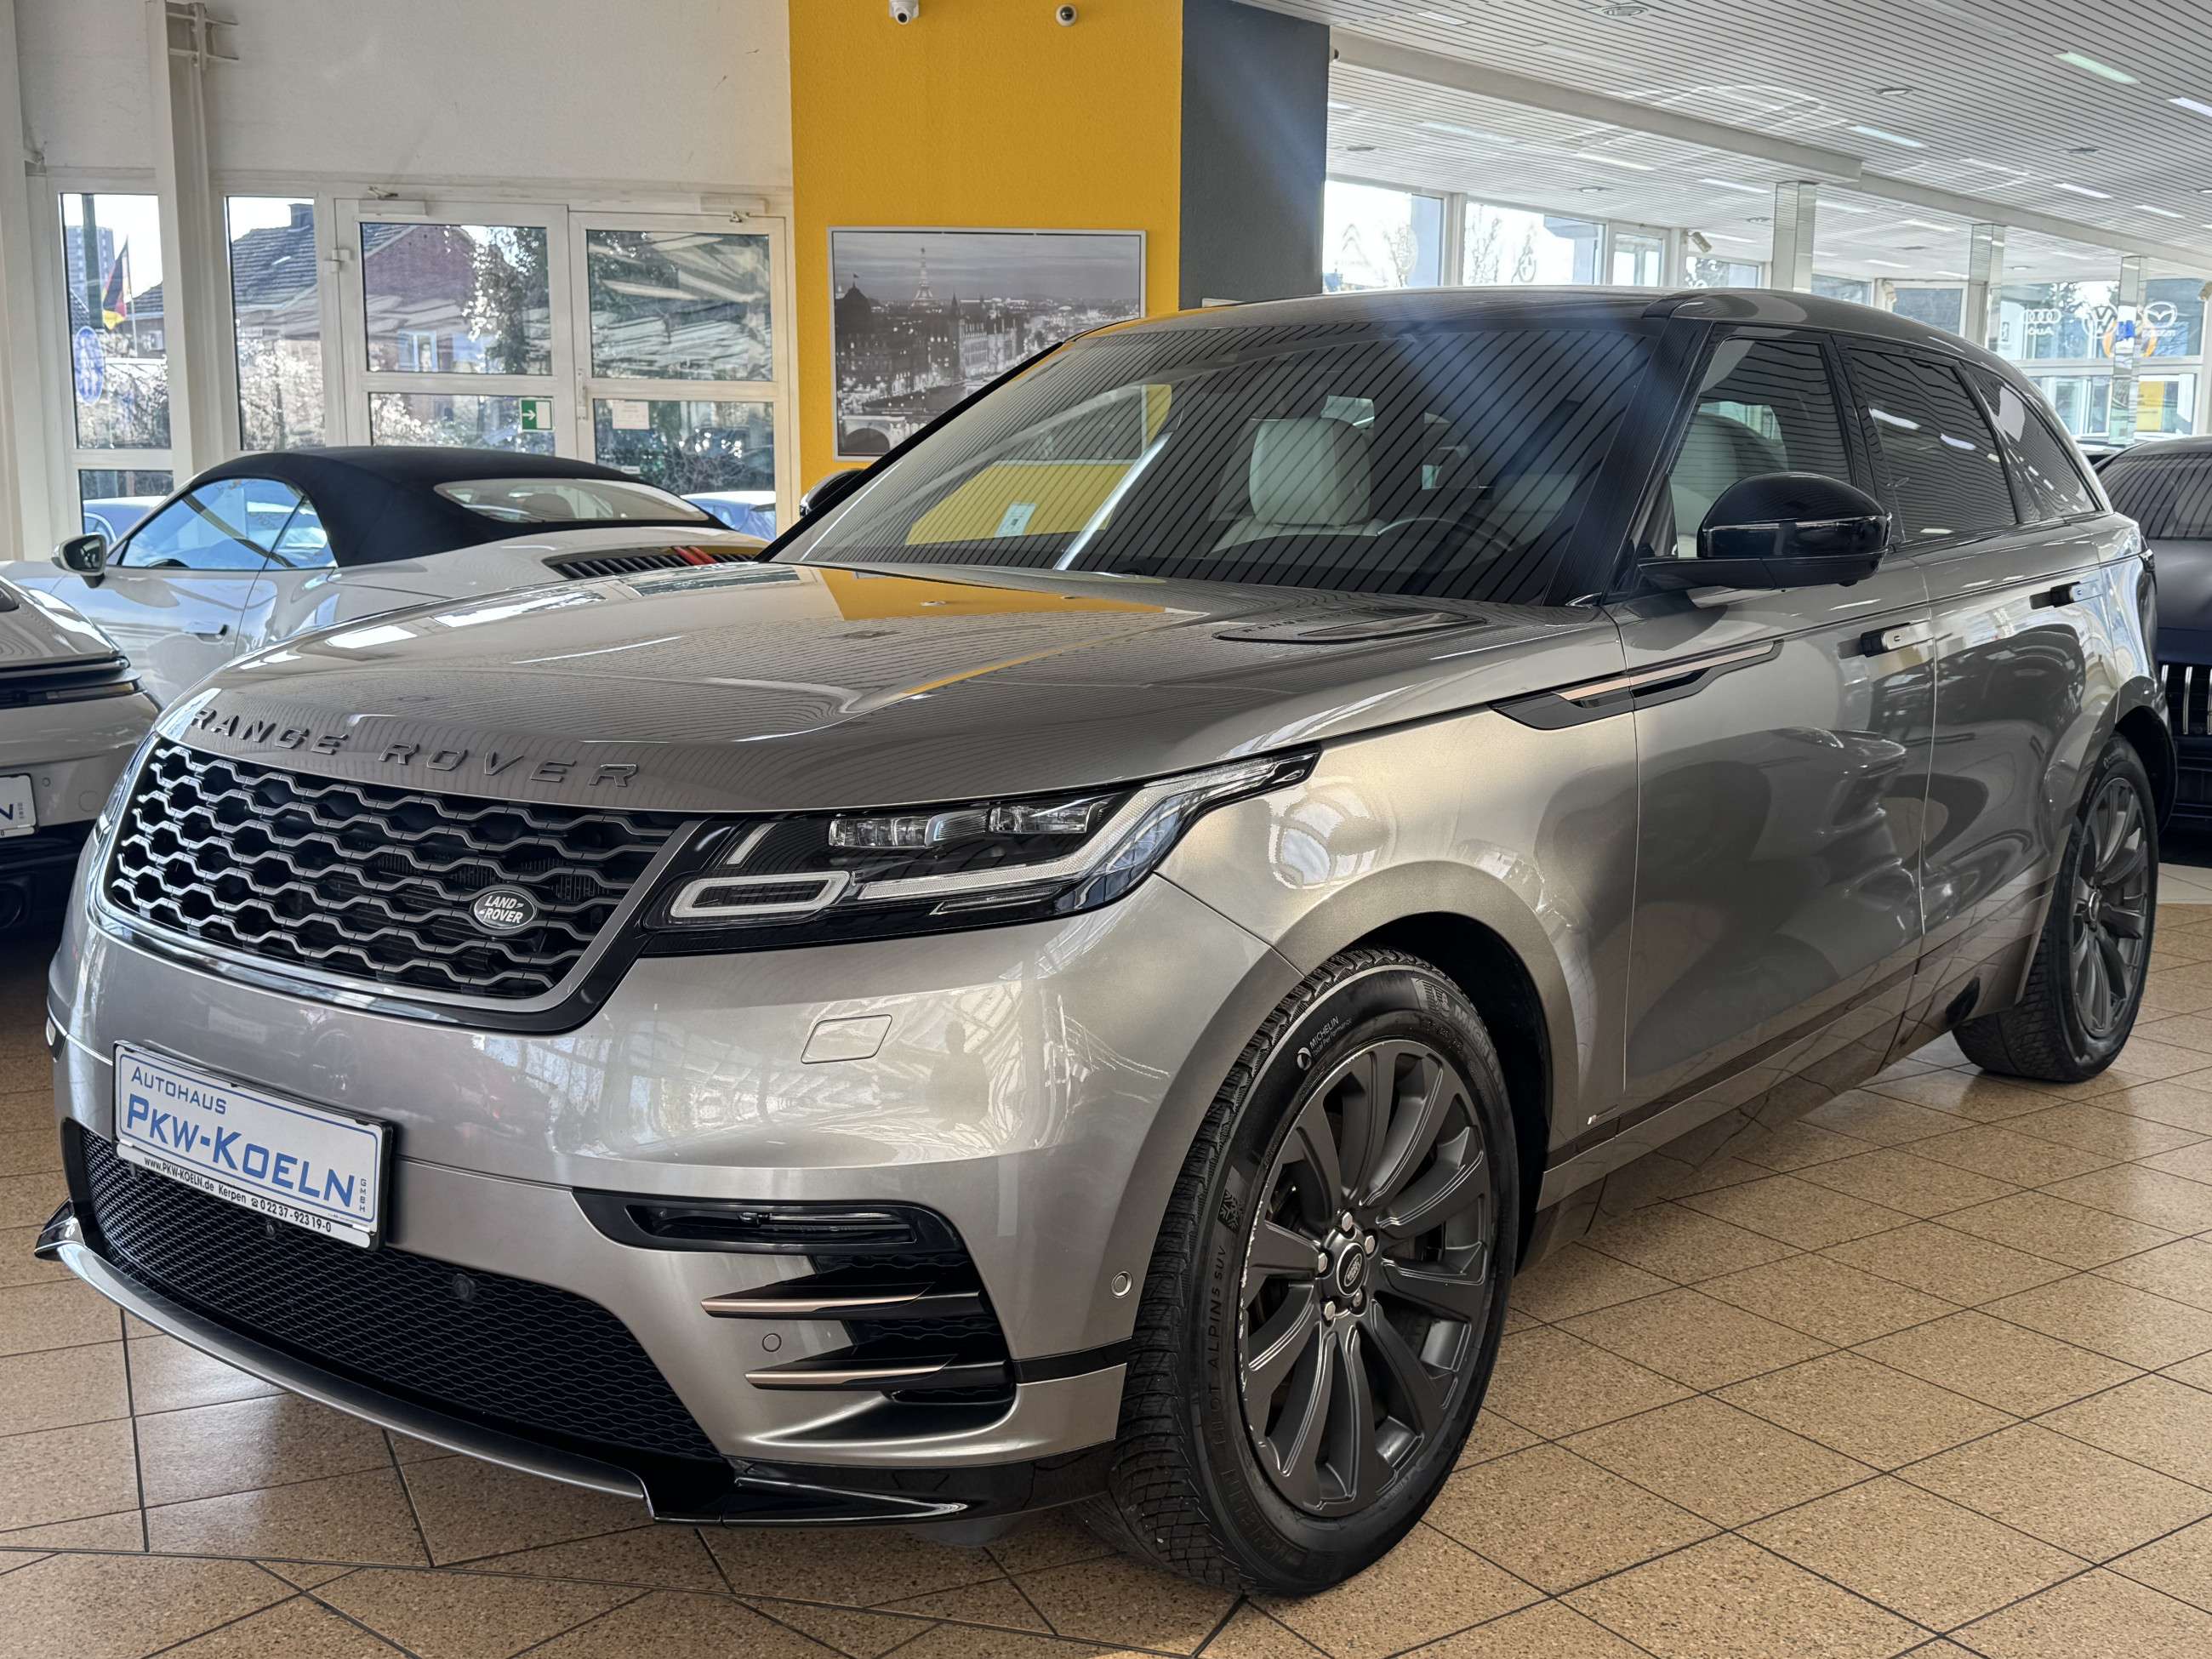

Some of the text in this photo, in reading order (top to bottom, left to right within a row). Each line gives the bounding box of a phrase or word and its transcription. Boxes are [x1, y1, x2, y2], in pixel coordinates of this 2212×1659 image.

[191, 707, 637, 788] RANGE ROVER
[482, 907, 524, 924] ROVER
[485, 895, 517, 909] LAND
[1309, 1016, 1339, 1049] MICHELIN
[131, 1066, 227, 1115] AUTOHAUS
[127, 1093, 355, 1208] PKW-KOELN
[144, 1156, 214, 1192] www.PKW-KOELN.de
[218, 1183, 247, 1205] Kerpen
[1213, 1246, 1226, 1280] SUV
[1207, 1298, 1223, 1369] ALPIN
